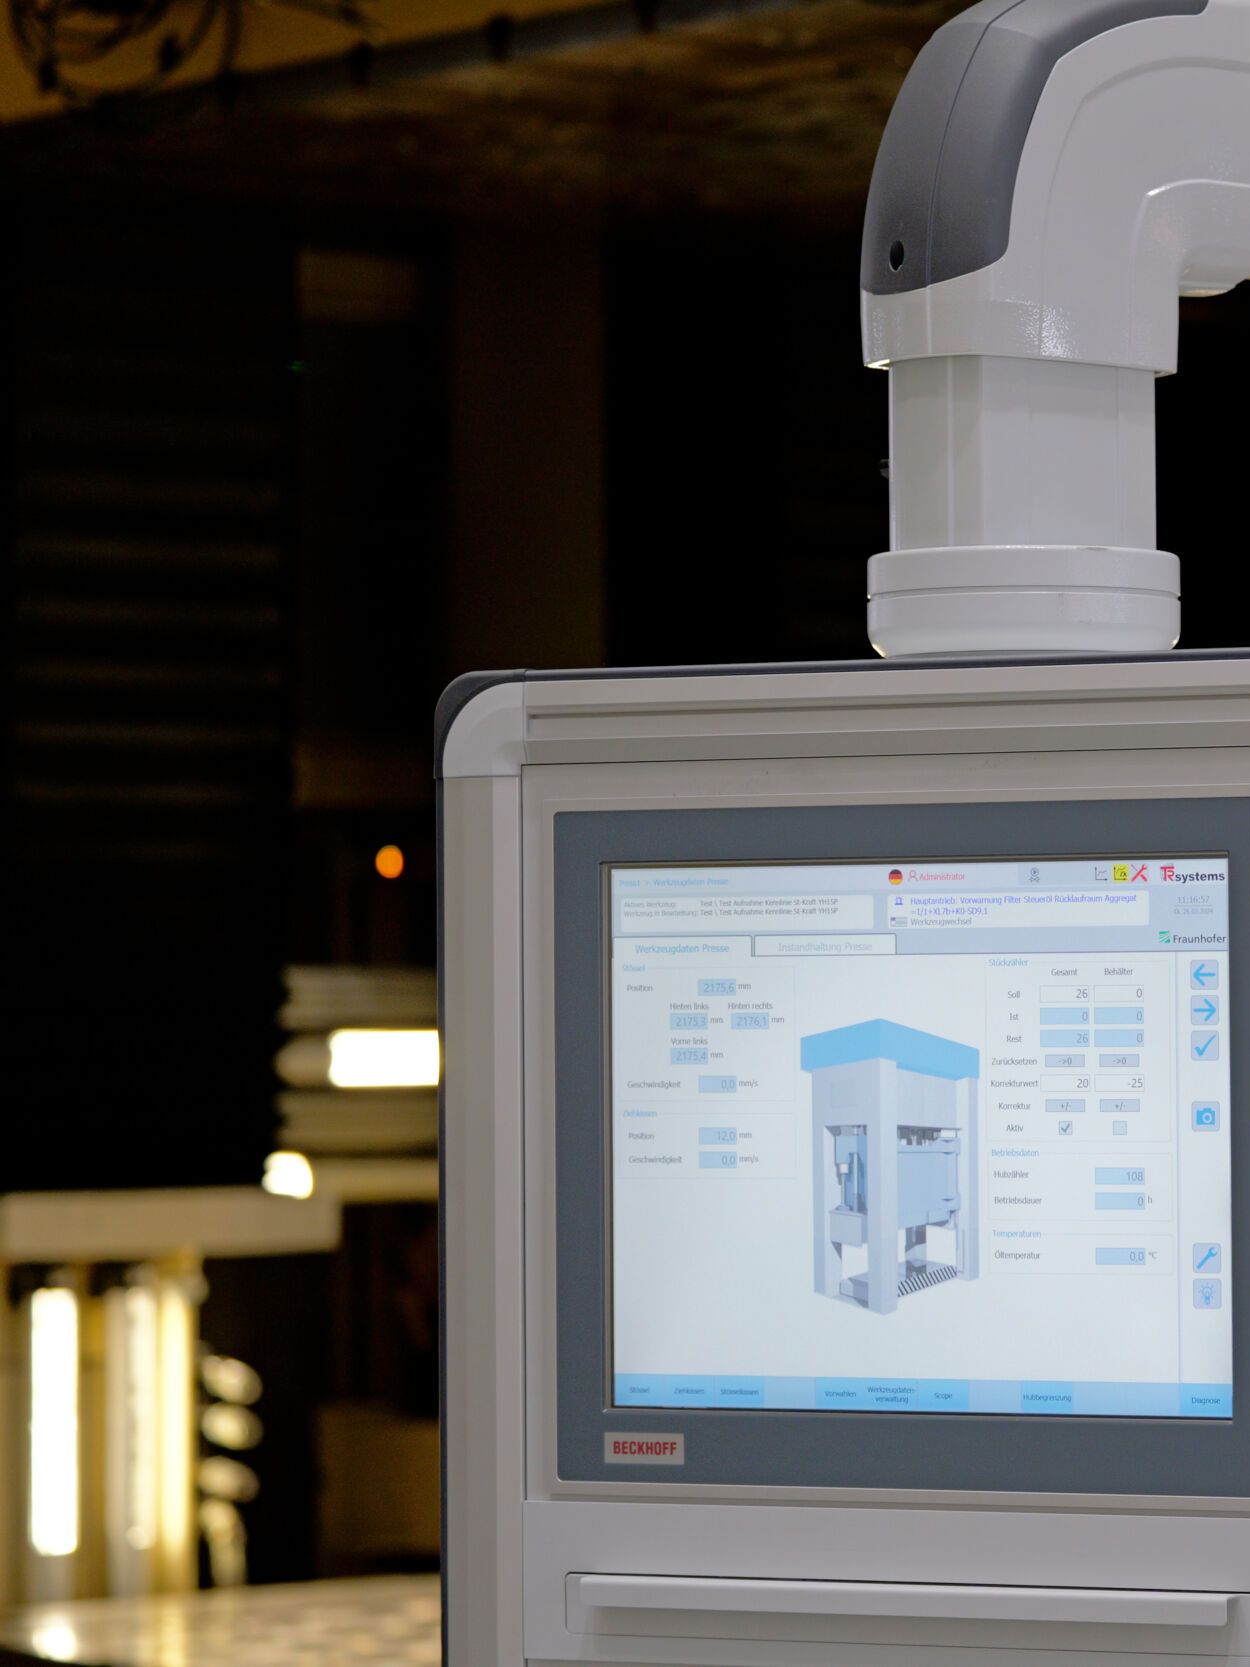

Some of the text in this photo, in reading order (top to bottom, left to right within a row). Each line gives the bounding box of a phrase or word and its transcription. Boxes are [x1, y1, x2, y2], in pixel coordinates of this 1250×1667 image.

[919, 872, 965, 880] Administrator
[910, 896, 958, 906] Hauptantrieb:
[960, 896, 1002, 905] Vorwarnung
[1104, 894, 1137, 904] Aggregat
[910, 918, 972, 926] Werkzeugwechsel
[1173, 934, 1226, 944] Fraunhofer
[635, 944, 730, 954] Werkzeugdaten Presse
[778, 942, 872, 952] Instandhaltung Presse
[988, 958, 1028, 967] Stückzähler
[1051, 968, 1133, 976] Gesamt Behälter
[627, 984, 653, 992] Position
[703, 982, 735, 994] 2175,6
[1008, 988, 1142, 998] Soll 26 0
[693, 1002, 709, 1010] links
[728, 1002, 773, 1010] Hinten rechts
[1010, 1011, 1142, 1021] Ist 0 0
[736, 1016, 767, 1026] 2176,1
[670, 1038, 691, 1046] Vorne
[1076, 1034, 1088, 1044] 26
[1136, 1033, 1143, 1043] 0
[992, 1057, 1038, 1066] Zurücksetzen
[627, 1080, 759, 1090] Geschwindigkeit 0,0 mm/s
[990, 1078, 1143, 1088] Korrekturwert 20 -25
[998, 1102, 1031, 1110] Korrektur
[1006, 1124, 1024, 1132] Aktiv
[628, 1132, 655, 1141] Position
[992, 1149, 1039, 1157] Betriebsdaten
[628, 1154, 759, 1166] Geschwindigkeit 0,0 mm/s
[994, 1170, 1144, 1182] Hubzähler 108
[994, 1196, 1153, 1206] Betriebsdauer 0 h
[992, 1230, 1042, 1238] Temperaturen
[994, 1250, 1158, 1262] Öltemperatur 0,0 °C
[934, 1392, 952, 1400] Scope
[1024, 1394, 1072, 1402] Hubbegrenzung
[1191, 1396, 1220, 1405] Diagnose
[613, 1440, 677, 1456] BECKHOFF
